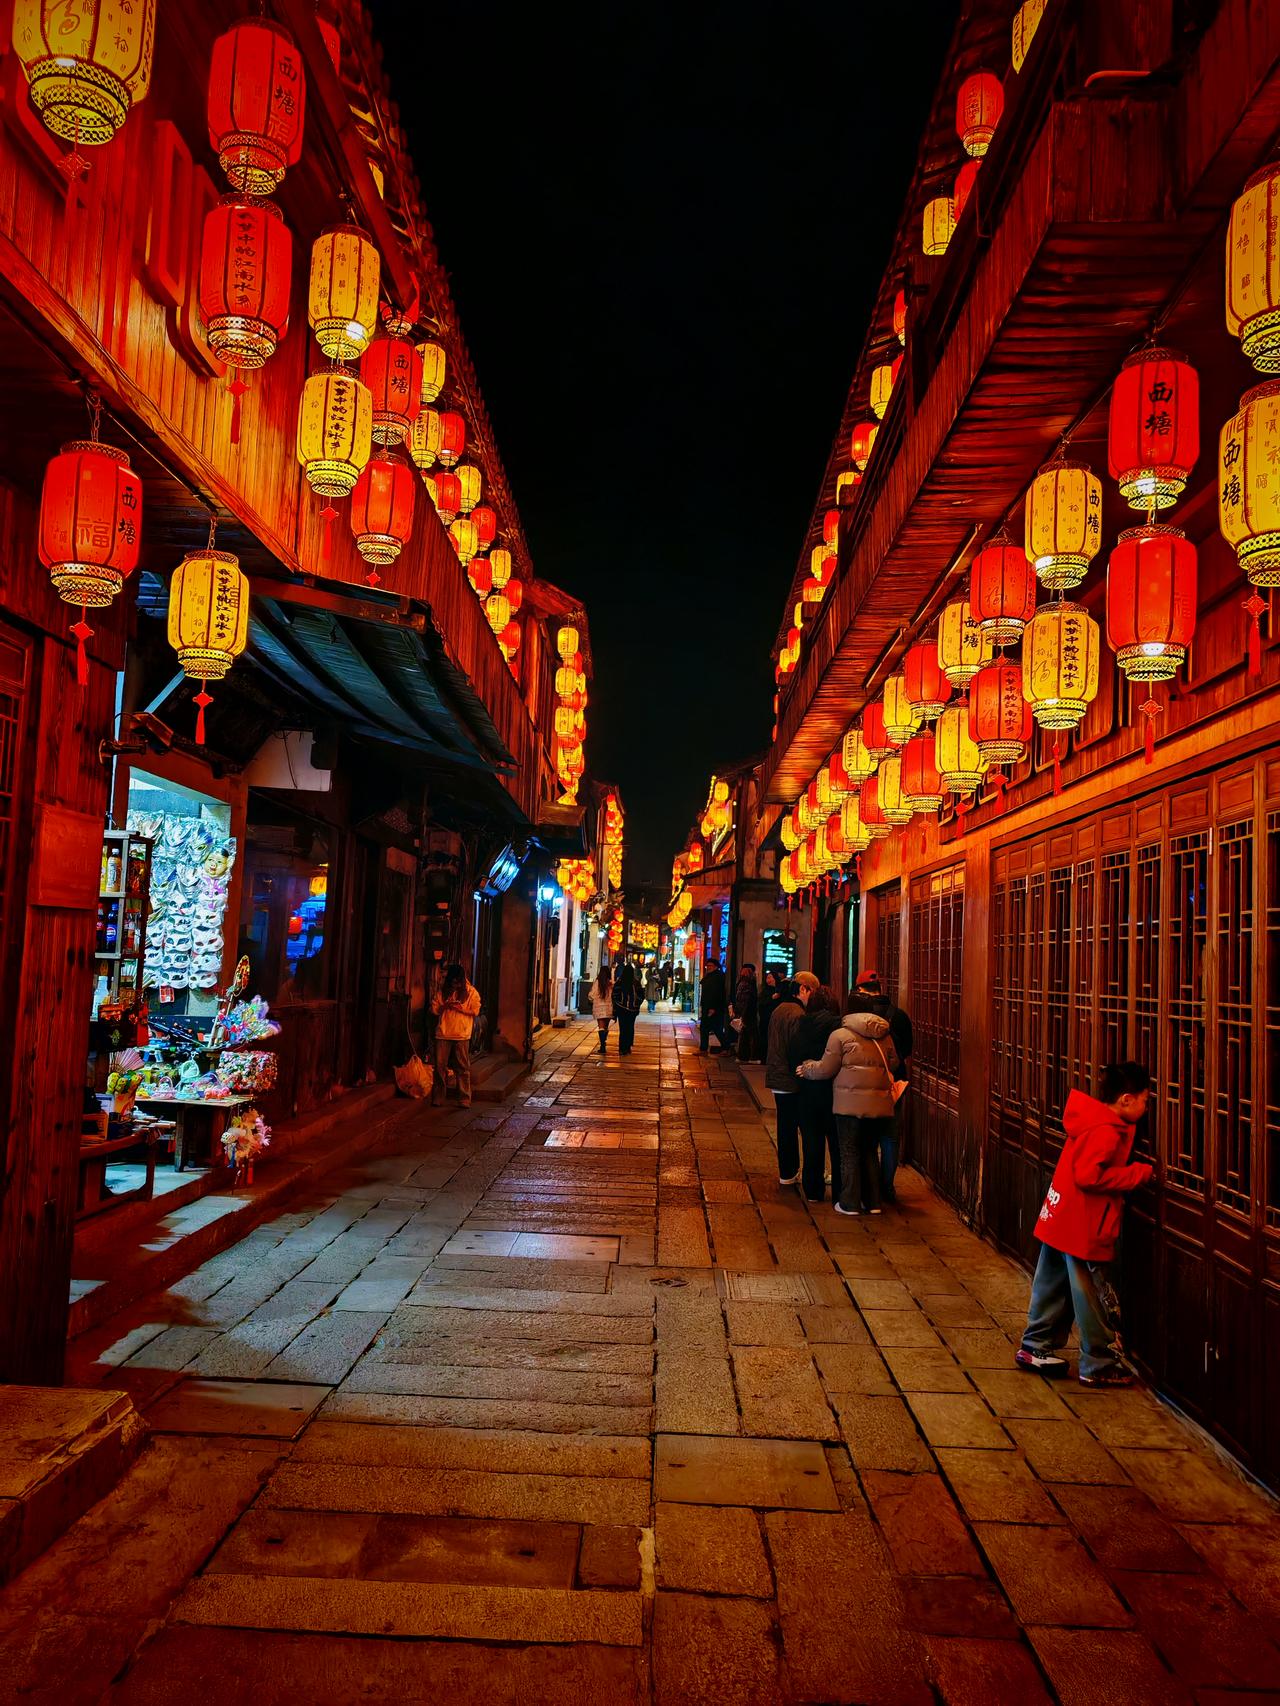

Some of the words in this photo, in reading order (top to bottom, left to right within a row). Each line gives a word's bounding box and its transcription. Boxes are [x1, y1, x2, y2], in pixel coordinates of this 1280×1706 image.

[274, 55, 298, 116] 西塘
[233, 211, 257, 310] 我梦中的江南水乡
[390, 354, 411, 395] 西塘
[329, 380, 350, 449] 我梦中的江南水乡
[1144, 381, 1173, 437] 西塘
[1221, 437, 1242, 512] 西塘
[77, 516, 111, 549] 福
[118, 485, 138, 546] 西塘
[1087, 488, 1100, 536] 西塘
[215, 568, 234, 641] 我梦中的江南水乡
[962, 616, 979, 649] 西塘
[1062, 618, 1082, 690] 我梦中的江南水乡
[1004, 670, 1019, 734] 我梦中的江南水乡
